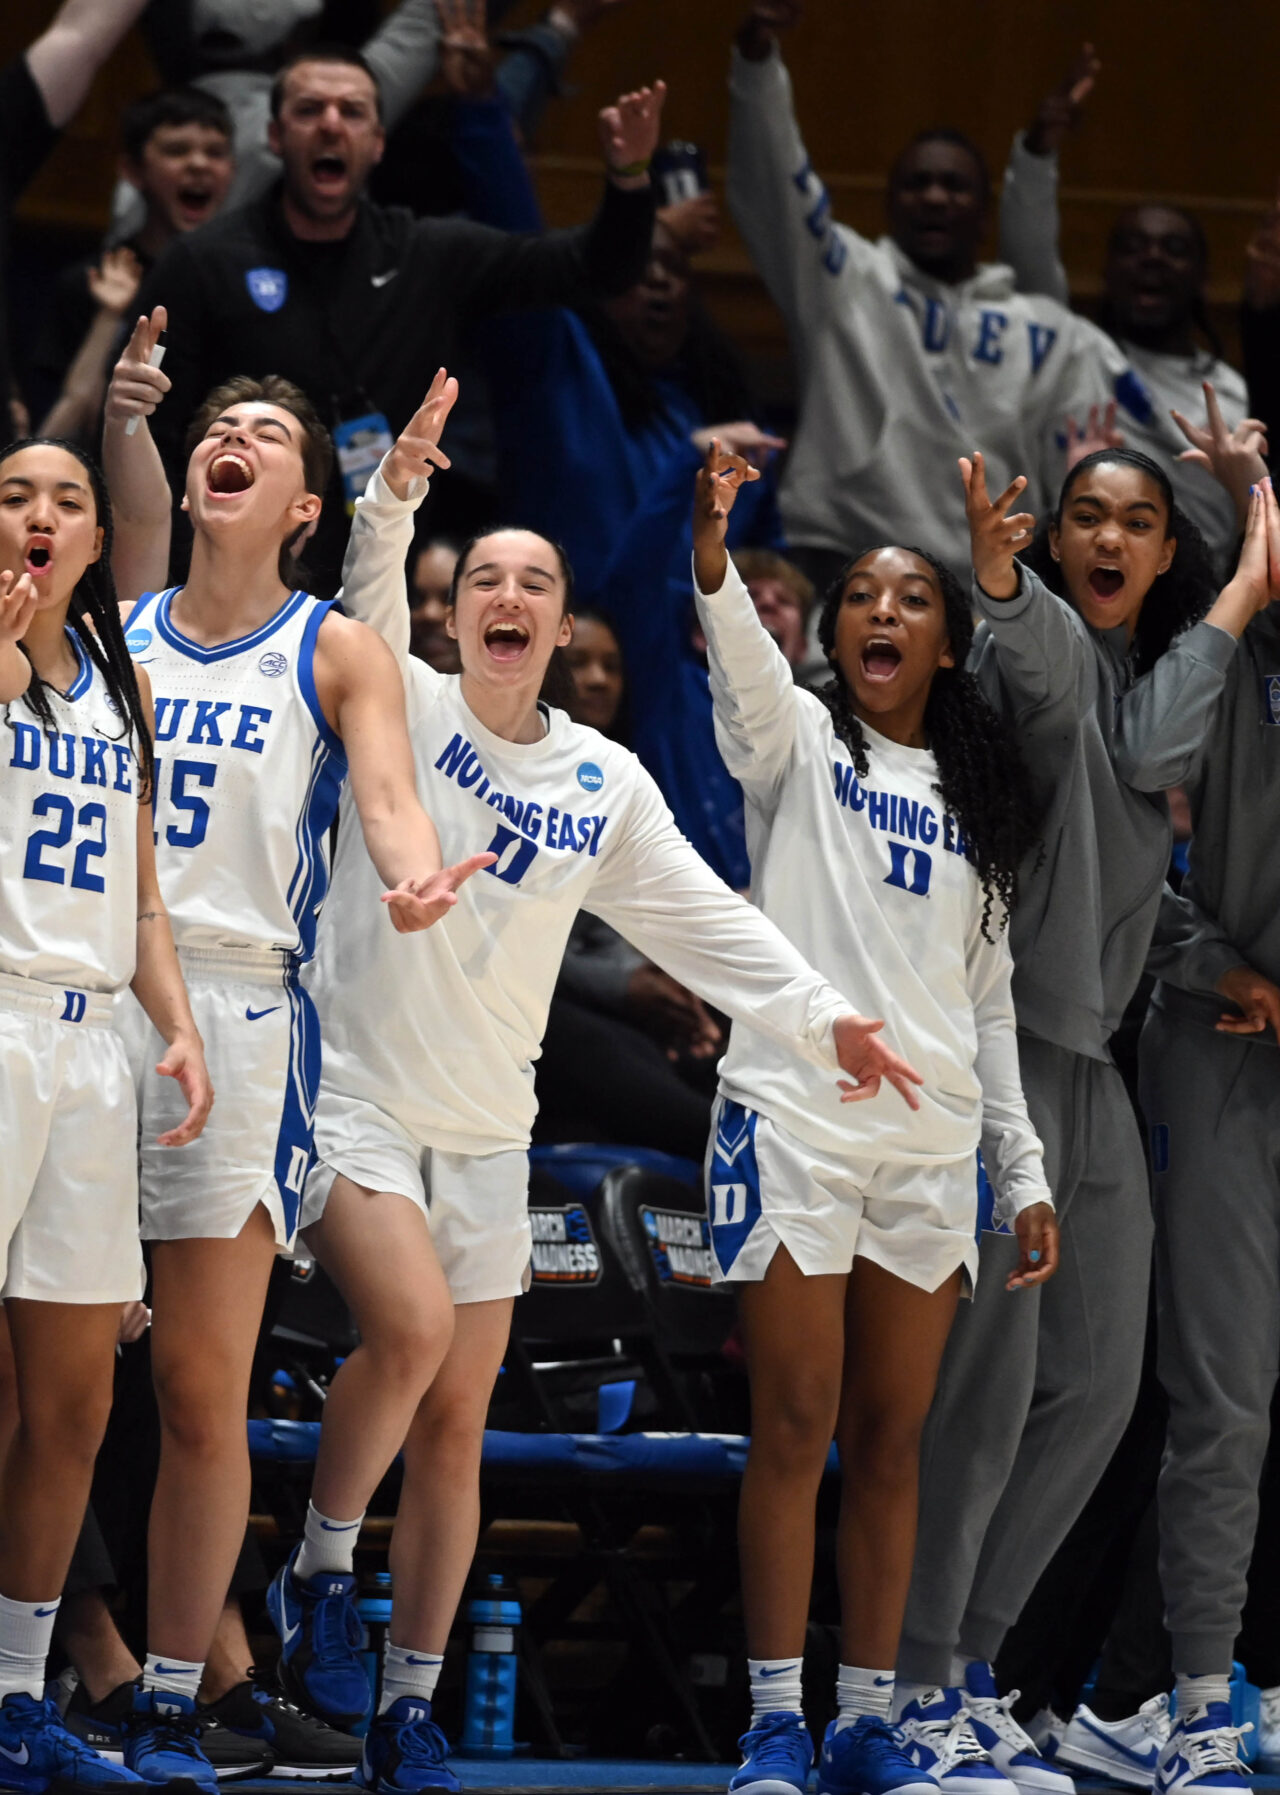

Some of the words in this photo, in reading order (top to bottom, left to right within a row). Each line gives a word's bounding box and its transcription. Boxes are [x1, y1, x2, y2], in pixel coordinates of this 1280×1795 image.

[154, 697, 273, 754] UKE
[10, 721, 133, 794] DUKE
[23, 792, 108, 894] 22
[545, 806, 608, 857] EASY
[531, 1212, 567, 1242] ARCH
